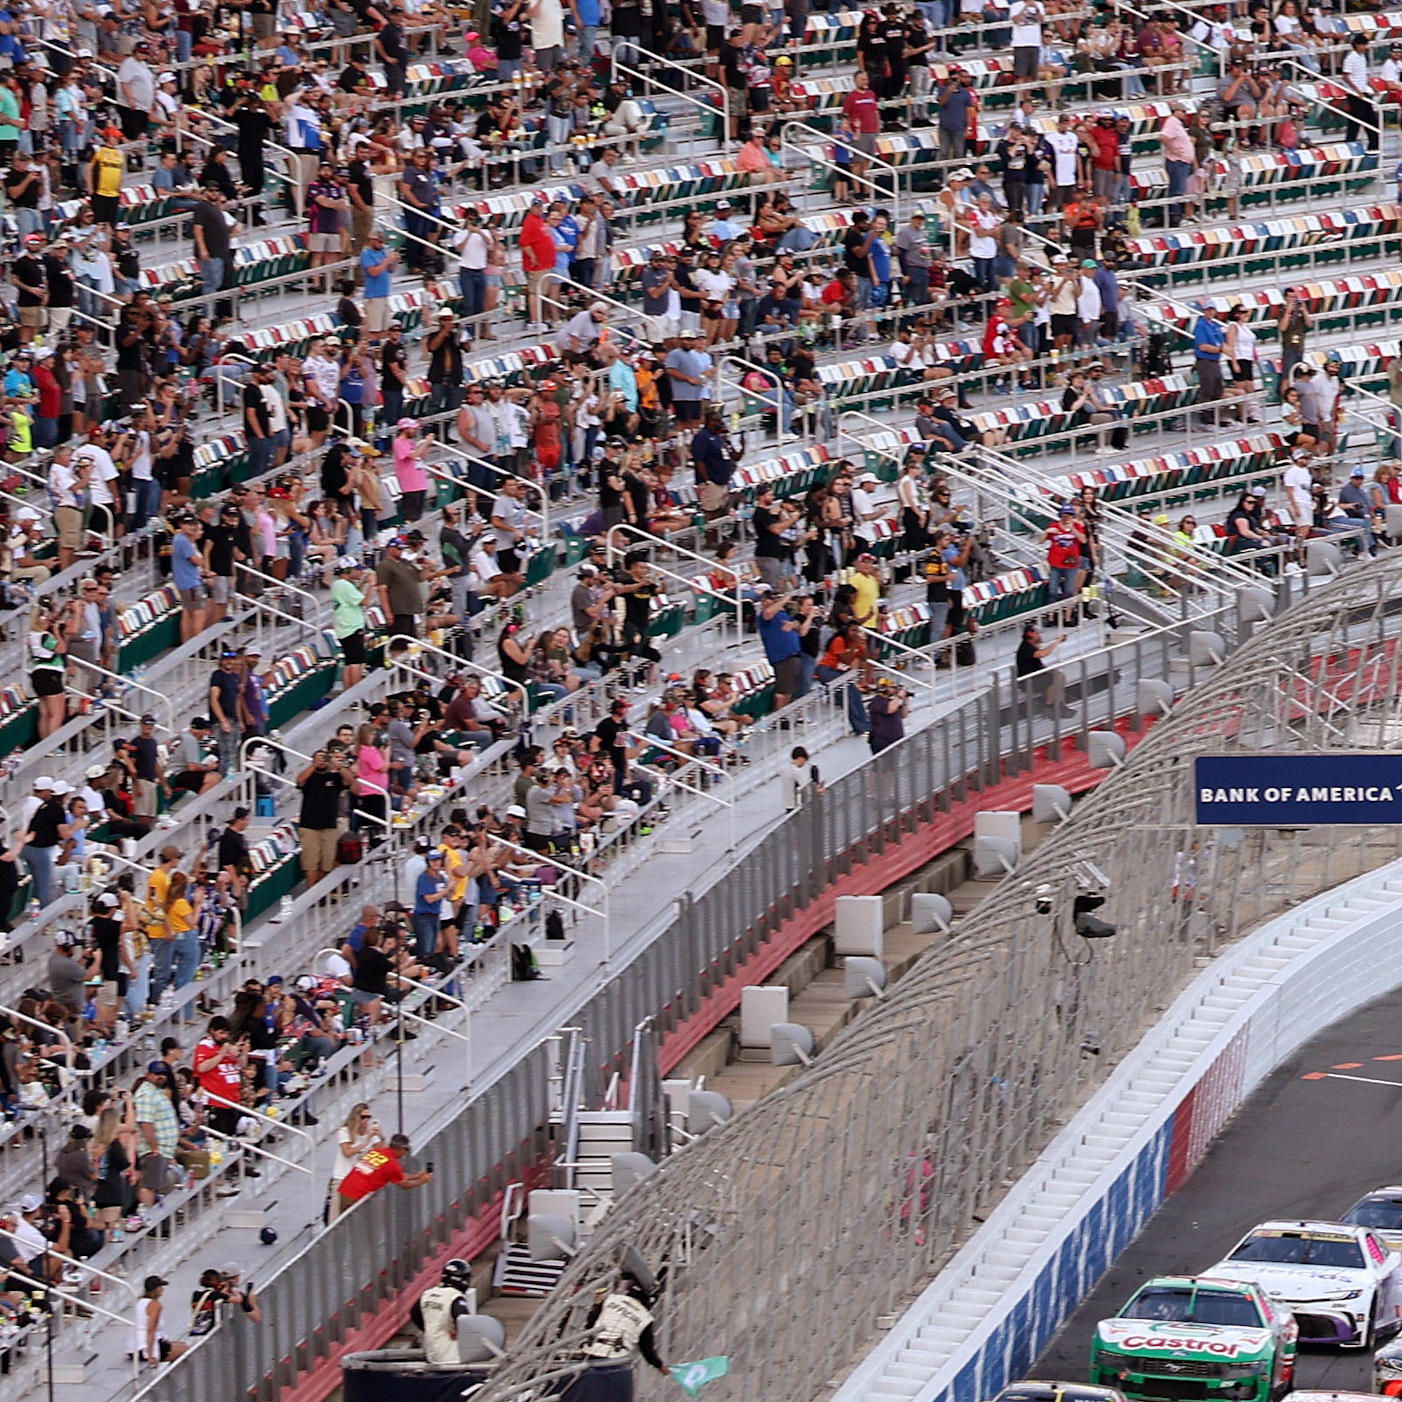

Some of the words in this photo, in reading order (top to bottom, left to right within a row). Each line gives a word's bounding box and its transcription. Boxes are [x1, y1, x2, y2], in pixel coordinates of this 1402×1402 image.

[1200, 788, 1260, 803] BANK
[1264, 787, 1293, 802] OF
[1296, 787, 1394, 802] AMERICA
[1123, 1336, 1240, 1356] Castrol
